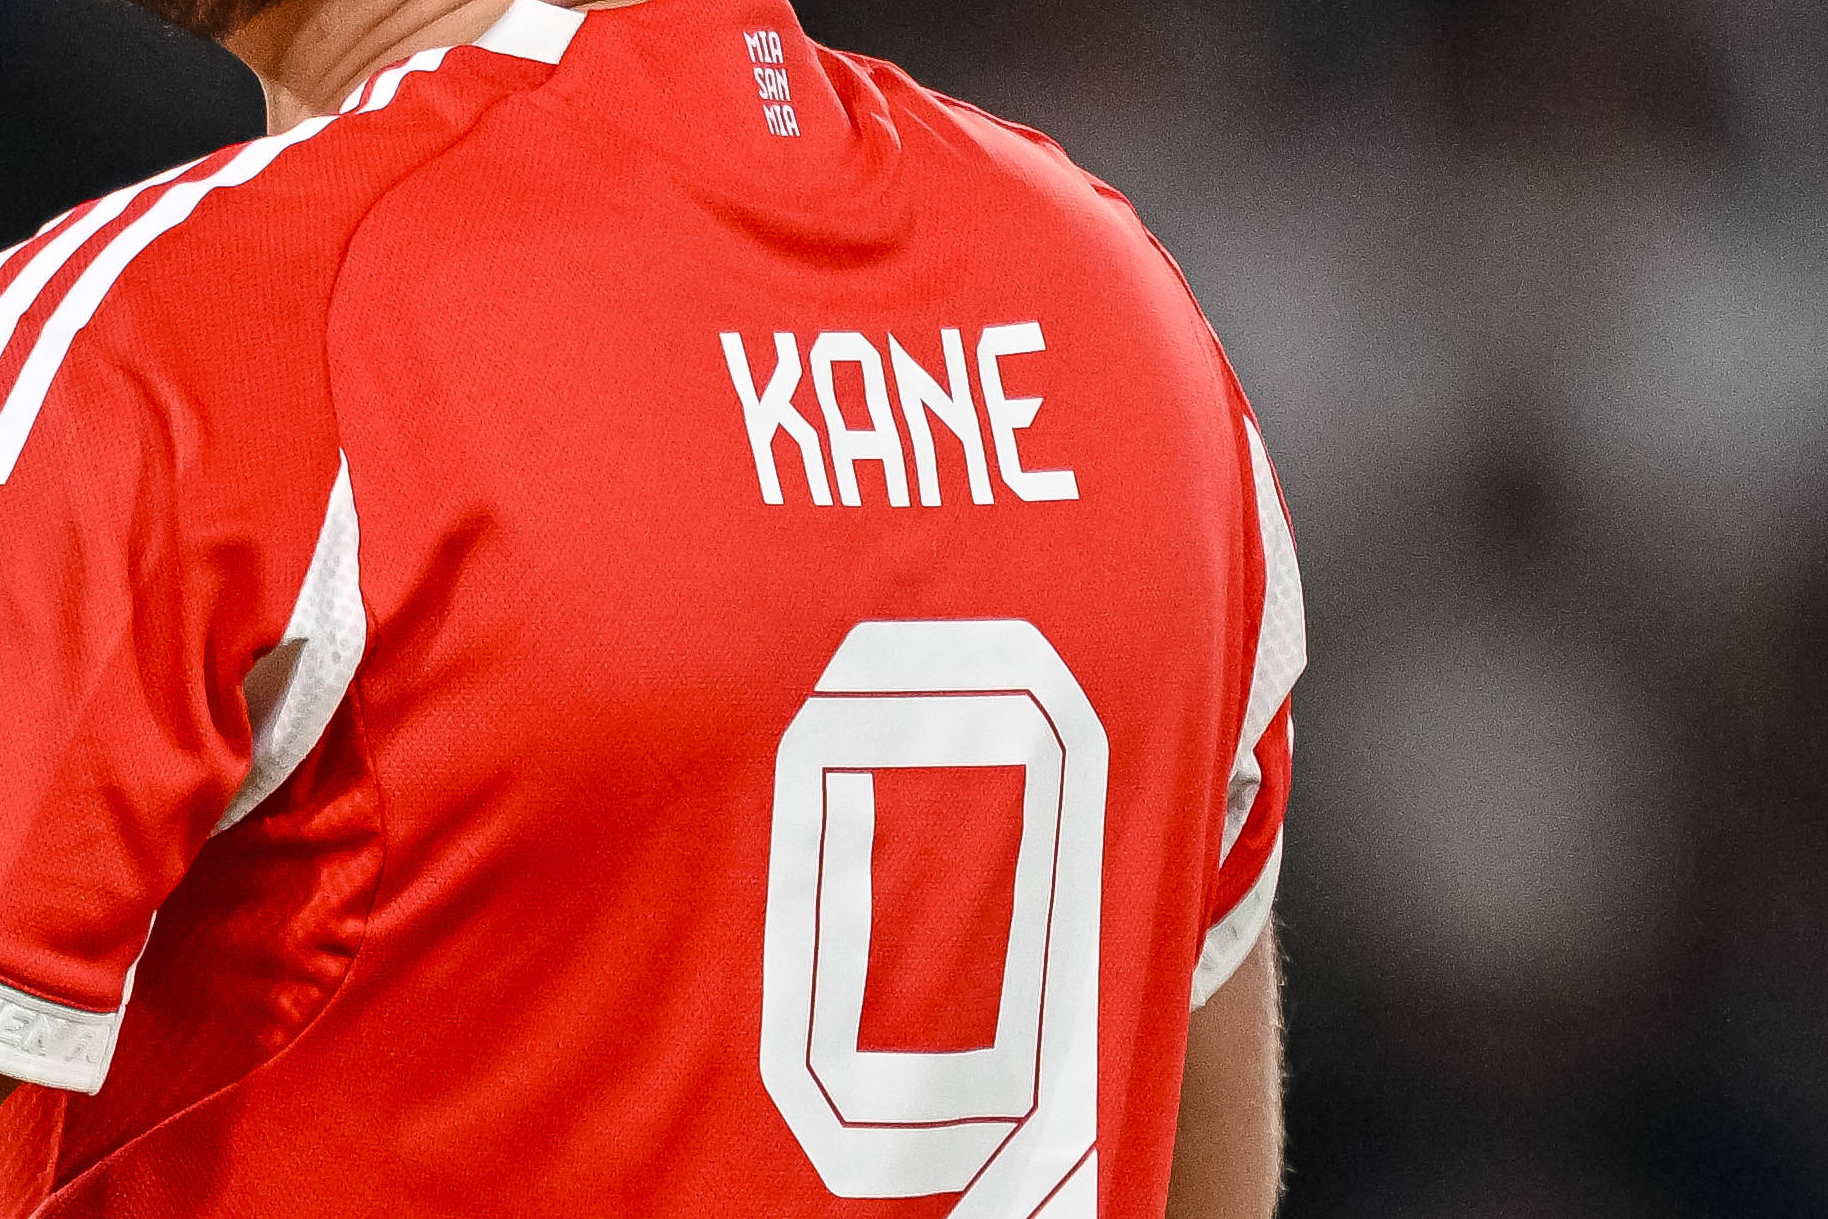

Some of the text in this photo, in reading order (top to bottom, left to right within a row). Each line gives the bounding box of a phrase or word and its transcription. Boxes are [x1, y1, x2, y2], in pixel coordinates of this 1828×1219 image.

[743, 30, 785, 64] MIA
[753, 67, 792, 102] SAN
[762, 104, 801, 137] MIA
[719, 320, 1080, 508] KANE
[760, 619, 1110, 1219] 9
